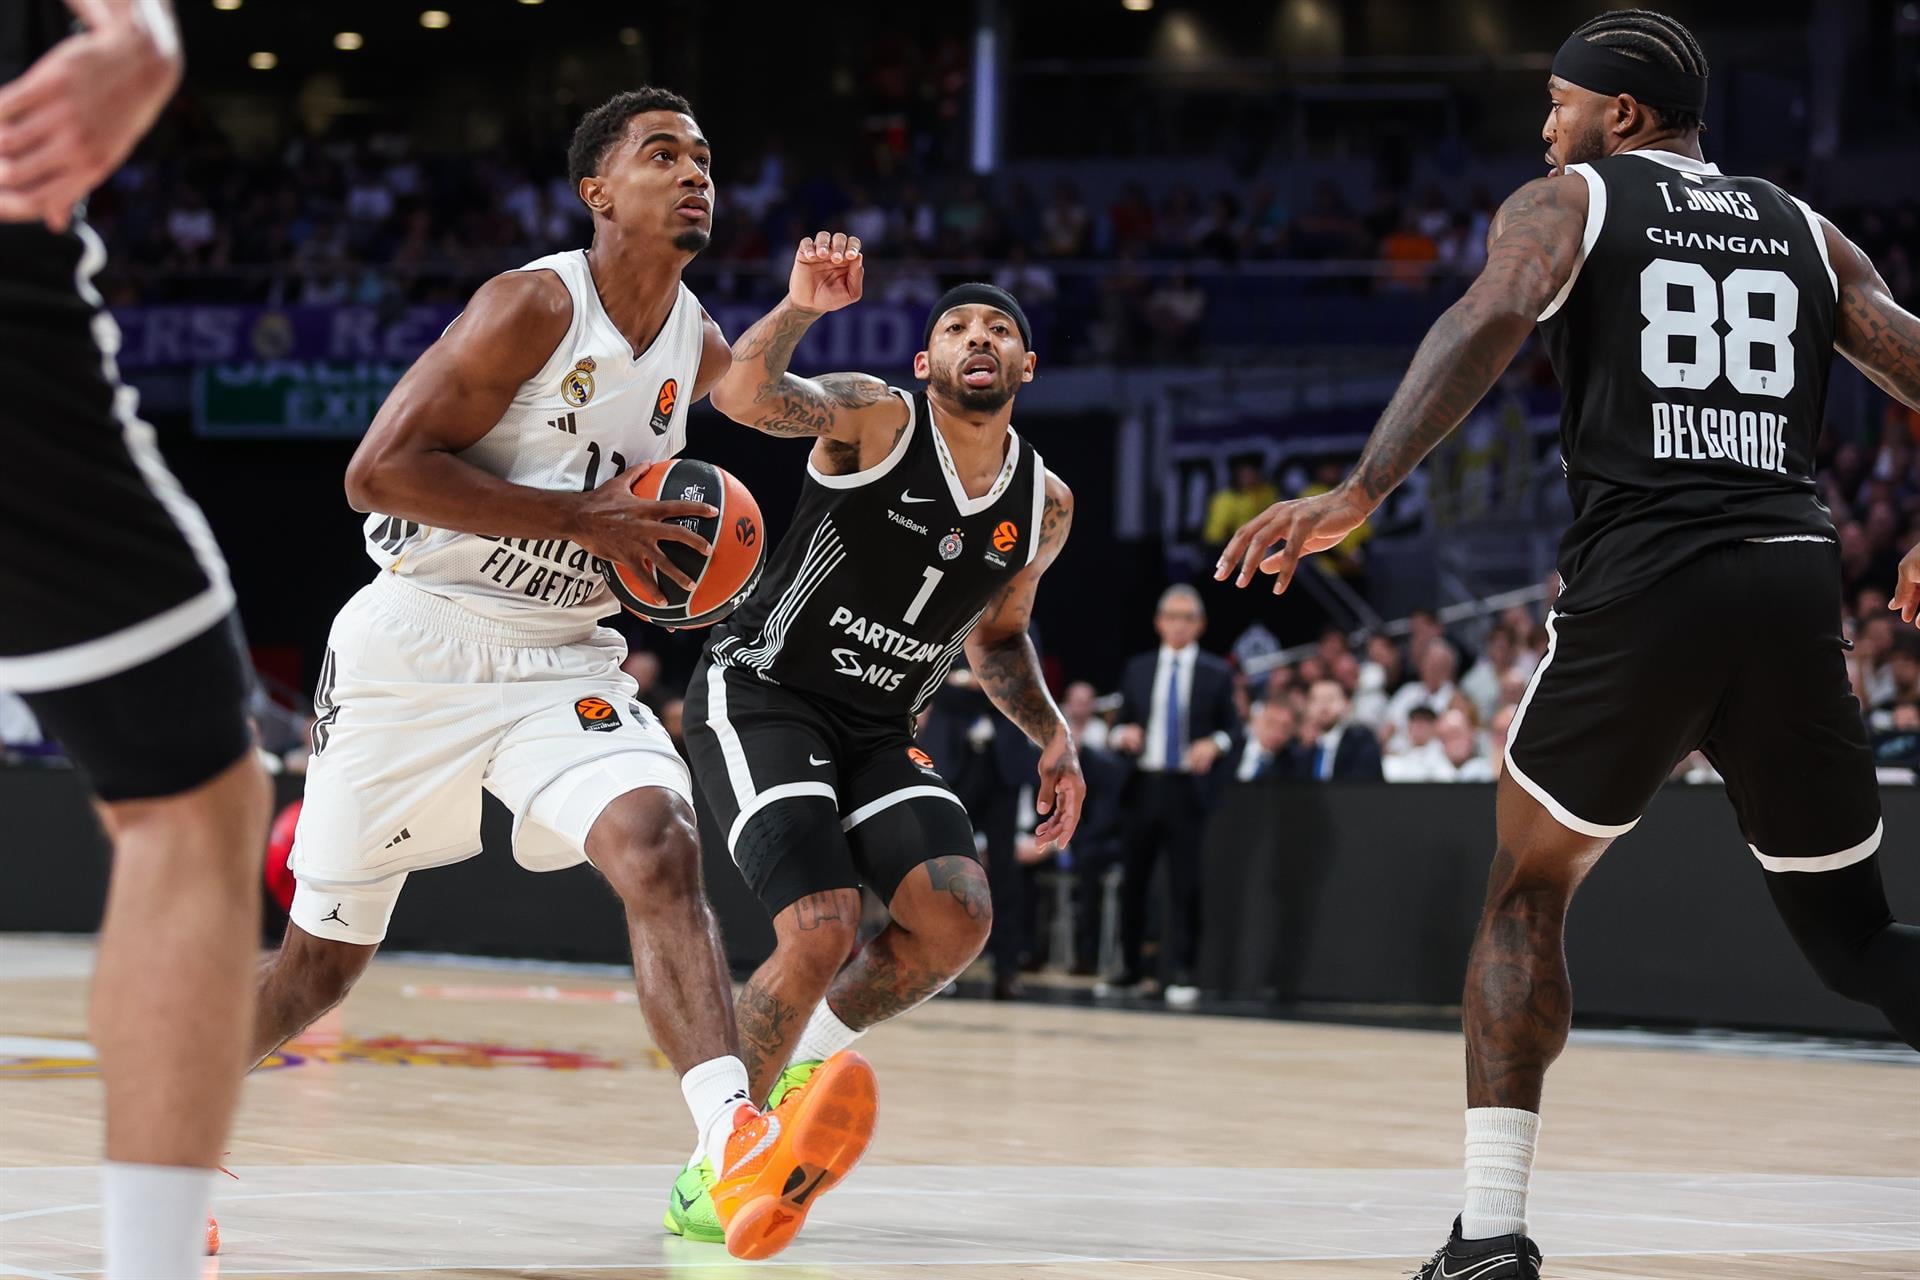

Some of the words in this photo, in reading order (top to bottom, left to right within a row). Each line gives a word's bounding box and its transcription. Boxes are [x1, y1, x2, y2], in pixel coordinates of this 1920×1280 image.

[1656, 181, 1683, 213] T.
[1684, 186, 1760, 221] JONES
[1645, 227, 1790, 256] CHANGAN
[1640, 257, 1799, 399] 88
[1651, 402, 1788, 475] BELGRADE
[892, 512, 929, 536] AikBank
[479, 546, 532, 589] FLY
[902, 565, 945, 626] 1
[828, 605, 944, 663] PARTIZAN
[861, 664, 907, 692] NIS
